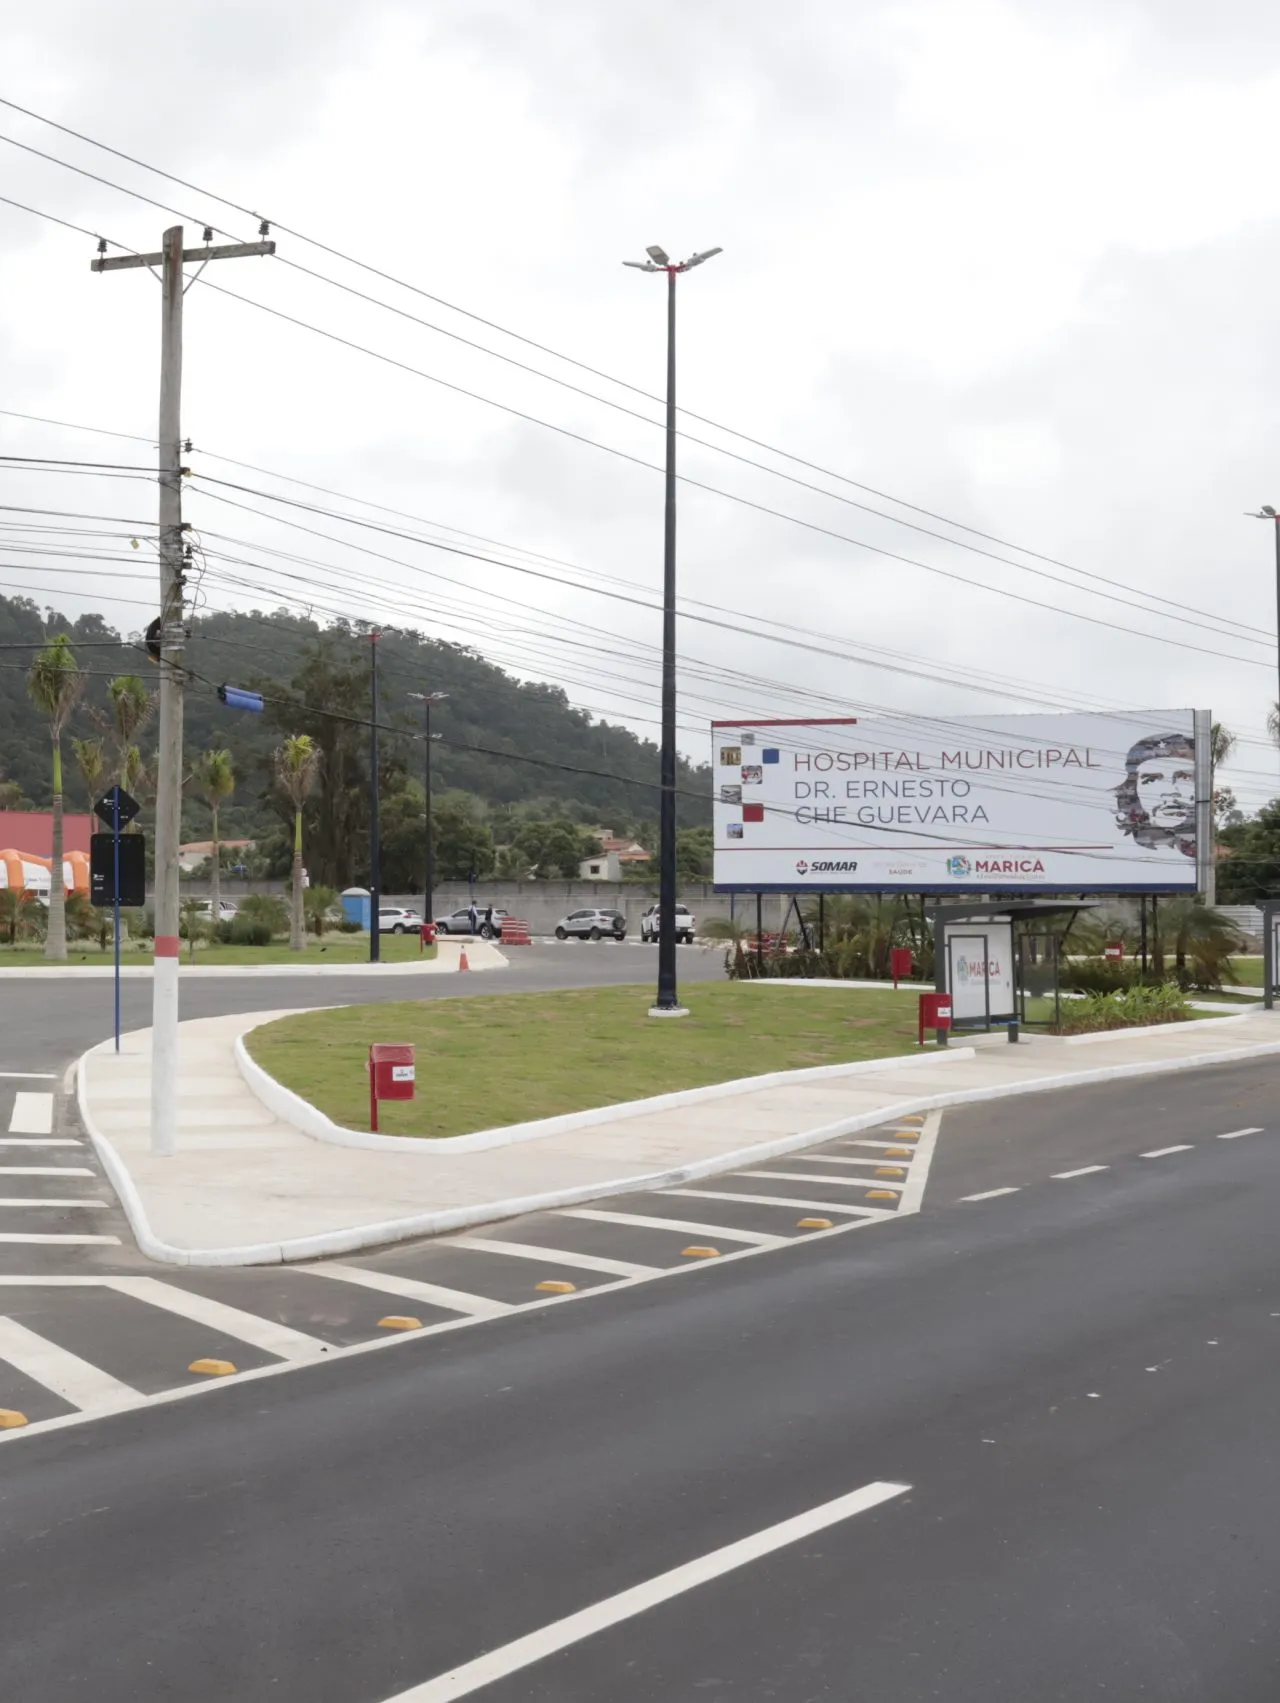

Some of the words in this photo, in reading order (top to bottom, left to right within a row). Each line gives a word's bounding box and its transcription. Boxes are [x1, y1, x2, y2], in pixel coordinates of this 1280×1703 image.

[794, 752, 930, 772] HOSPITAL
[941, 748, 1101, 770] MUNICIPAL
[794, 781, 836, 799] DR.
[846, 779, 971, 798] ERNESTO
[795, 806, 847, 825] CHE
[857, 805, 989, 823] GUEVARA
[810, 861, 858, 872] SOMAR
